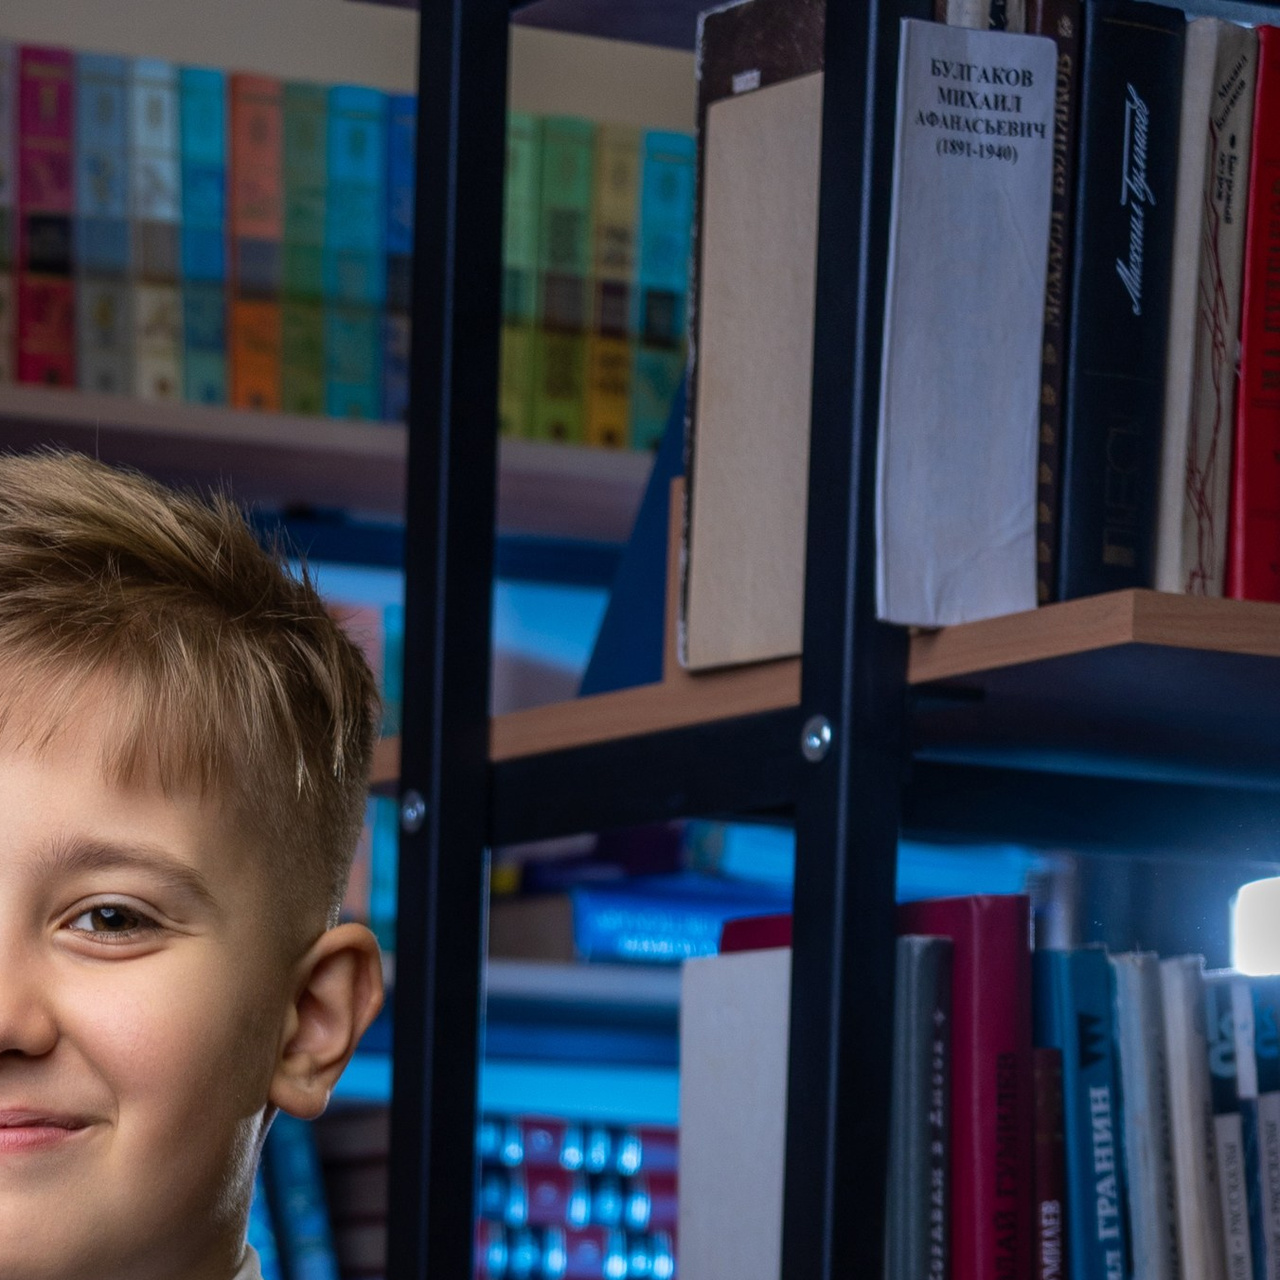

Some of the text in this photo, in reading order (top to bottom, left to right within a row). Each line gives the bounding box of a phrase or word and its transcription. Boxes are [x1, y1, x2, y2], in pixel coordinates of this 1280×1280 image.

[931, 58, 1033, 87] БУЛГАКОВ
[938, 86, 1022, 113] МИХАИЛ
[916, 110, 1046, 138] АФАНАСЬЕВИЧ
[936, 137, 1018, 165] (1891-1940)
[1116, 83, 1157, 315] Михаил Булгаков
[994, 1051, 1019, 1198] ГУМИЛЕВ
[1090, 1085, 1119, 1242] ГРАНИН
